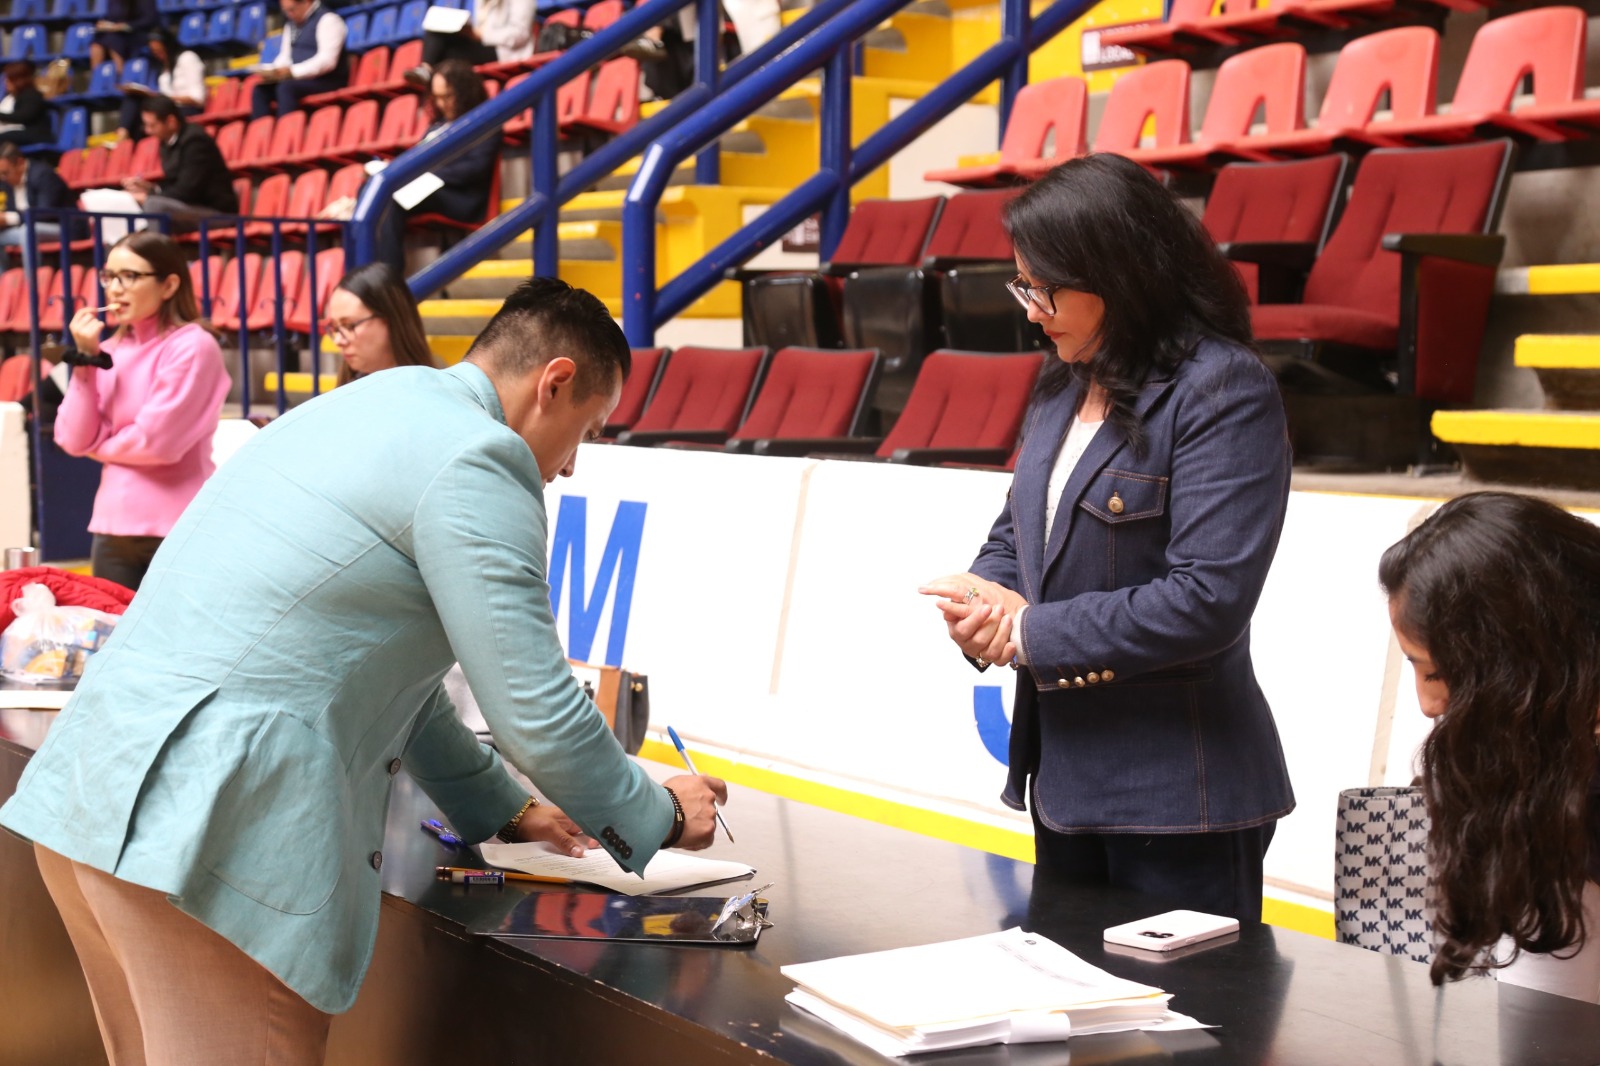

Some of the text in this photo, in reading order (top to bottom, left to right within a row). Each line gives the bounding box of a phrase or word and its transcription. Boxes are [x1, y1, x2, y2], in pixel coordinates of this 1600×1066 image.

[547, 495, 648, 668] M
[1349, 799, 1368, 811] MK
[1411, 797, 1425, 808] MK
[1369, 811, 1386, 822] MK
[1394, 809, 1409, 820] MK
[1347, 821, 1366, 833] MK
[1409, 819, 1425, 830] MK
[1367, 834, 1384, 845] MK
[1391, 831, 1406, 842] MK
[1345, 843, 1364, 855] MK
[1408, 842, 1426, 853] MK
[1364, 856, 1382, 866] MK
[1389, 854, 1406, 865] MK
[1343, 866, 1362, 877] MK
[1408, 865, 1426, 876] MK
[1363, 877, 1380, 888] MK
[1387, 876, 1405, 887] MK
[1341, 888, 1360, 899] MK
[1406, 887, 1424, 898] MK
[1360, 899, 1378, 909] MK
[1386, 898, 1403, 909] MK
[1341, 910, 1359, 921] MK
[1405, 909, 1423, 920] MK
[1362, 921, 1379, 932] MK
[1387, 921, 1404, 931] MK
[1342, 932, 1361, 944] MK
[1407, 932, 1426, 943] MK
[1391, 944, 1408, 955] MK
